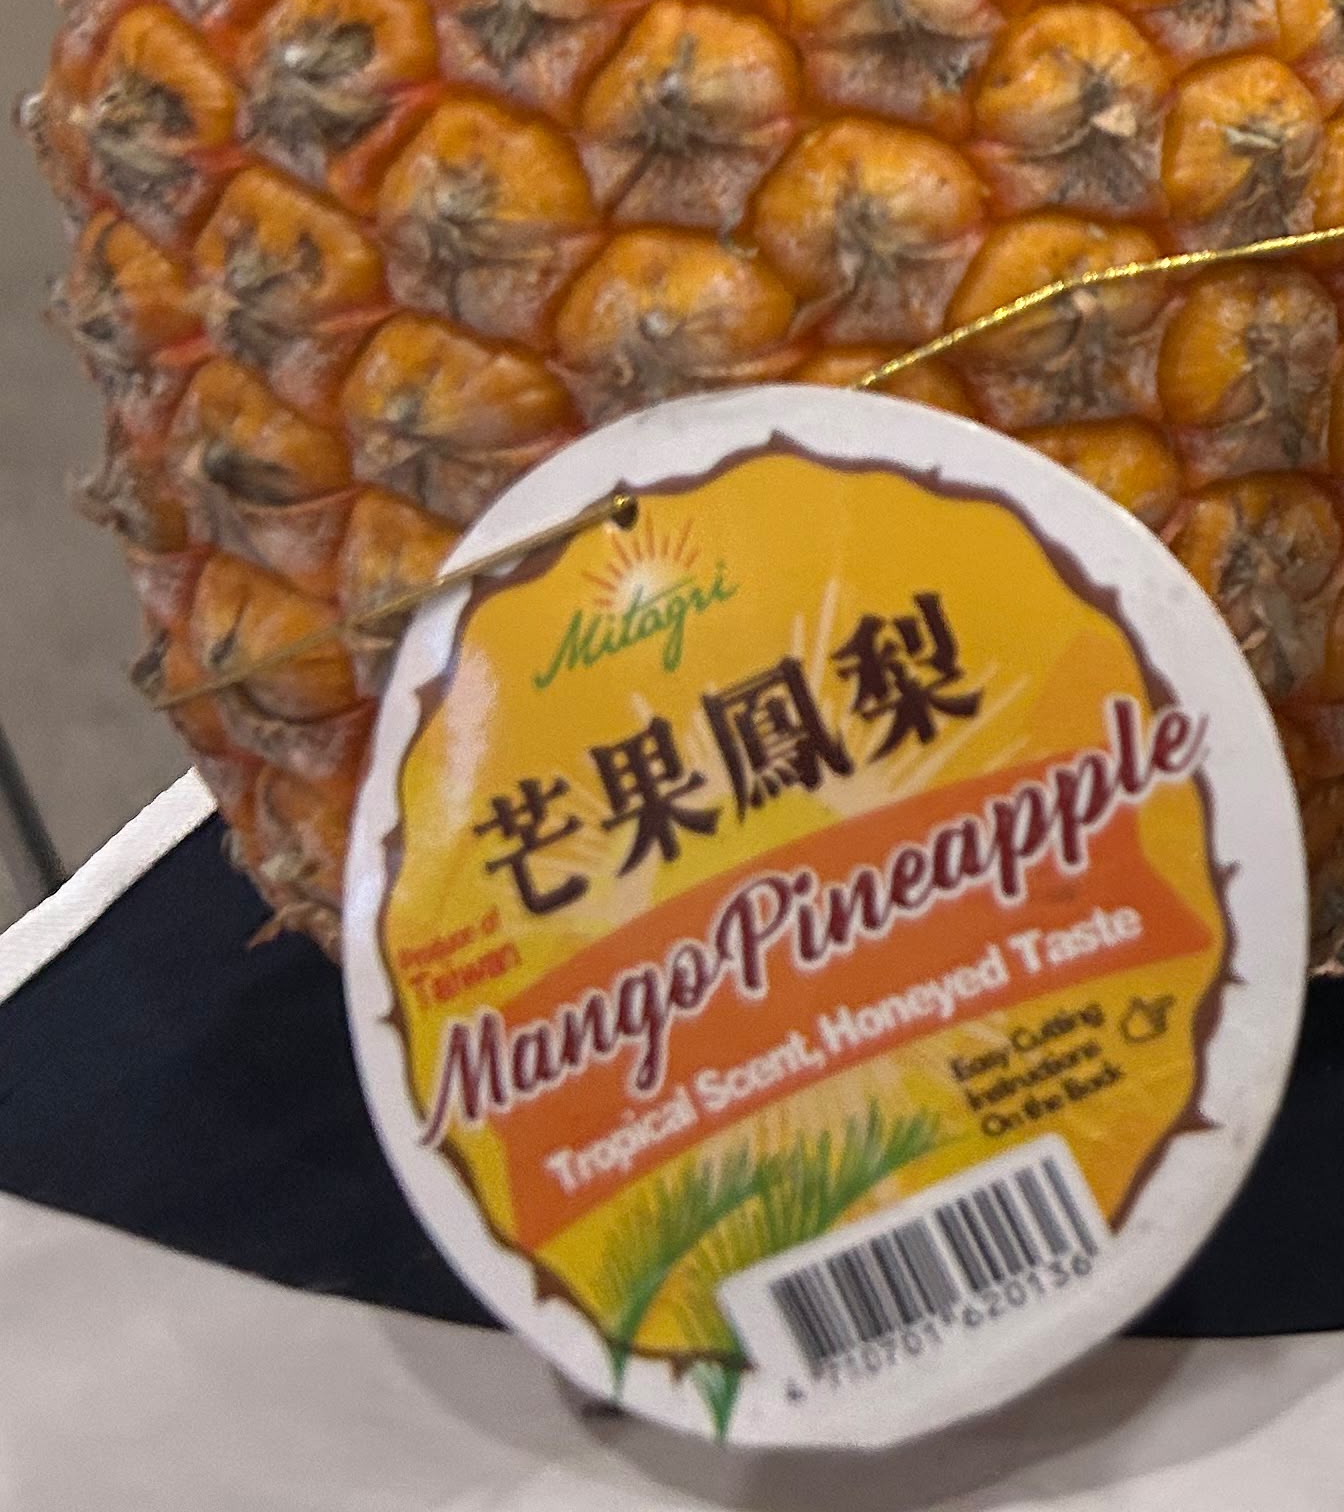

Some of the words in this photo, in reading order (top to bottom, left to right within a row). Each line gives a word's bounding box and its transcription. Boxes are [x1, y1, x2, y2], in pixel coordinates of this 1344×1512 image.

[473, 592, 984, 917] 芒果鳳梨
[546, 1100, 701, 1193] Tropical
[697, 1027, 828, 1110] Scent,
[818, 956, 1012, 1055] Honeyed
[1014, 906, 1144, 976] Taste
